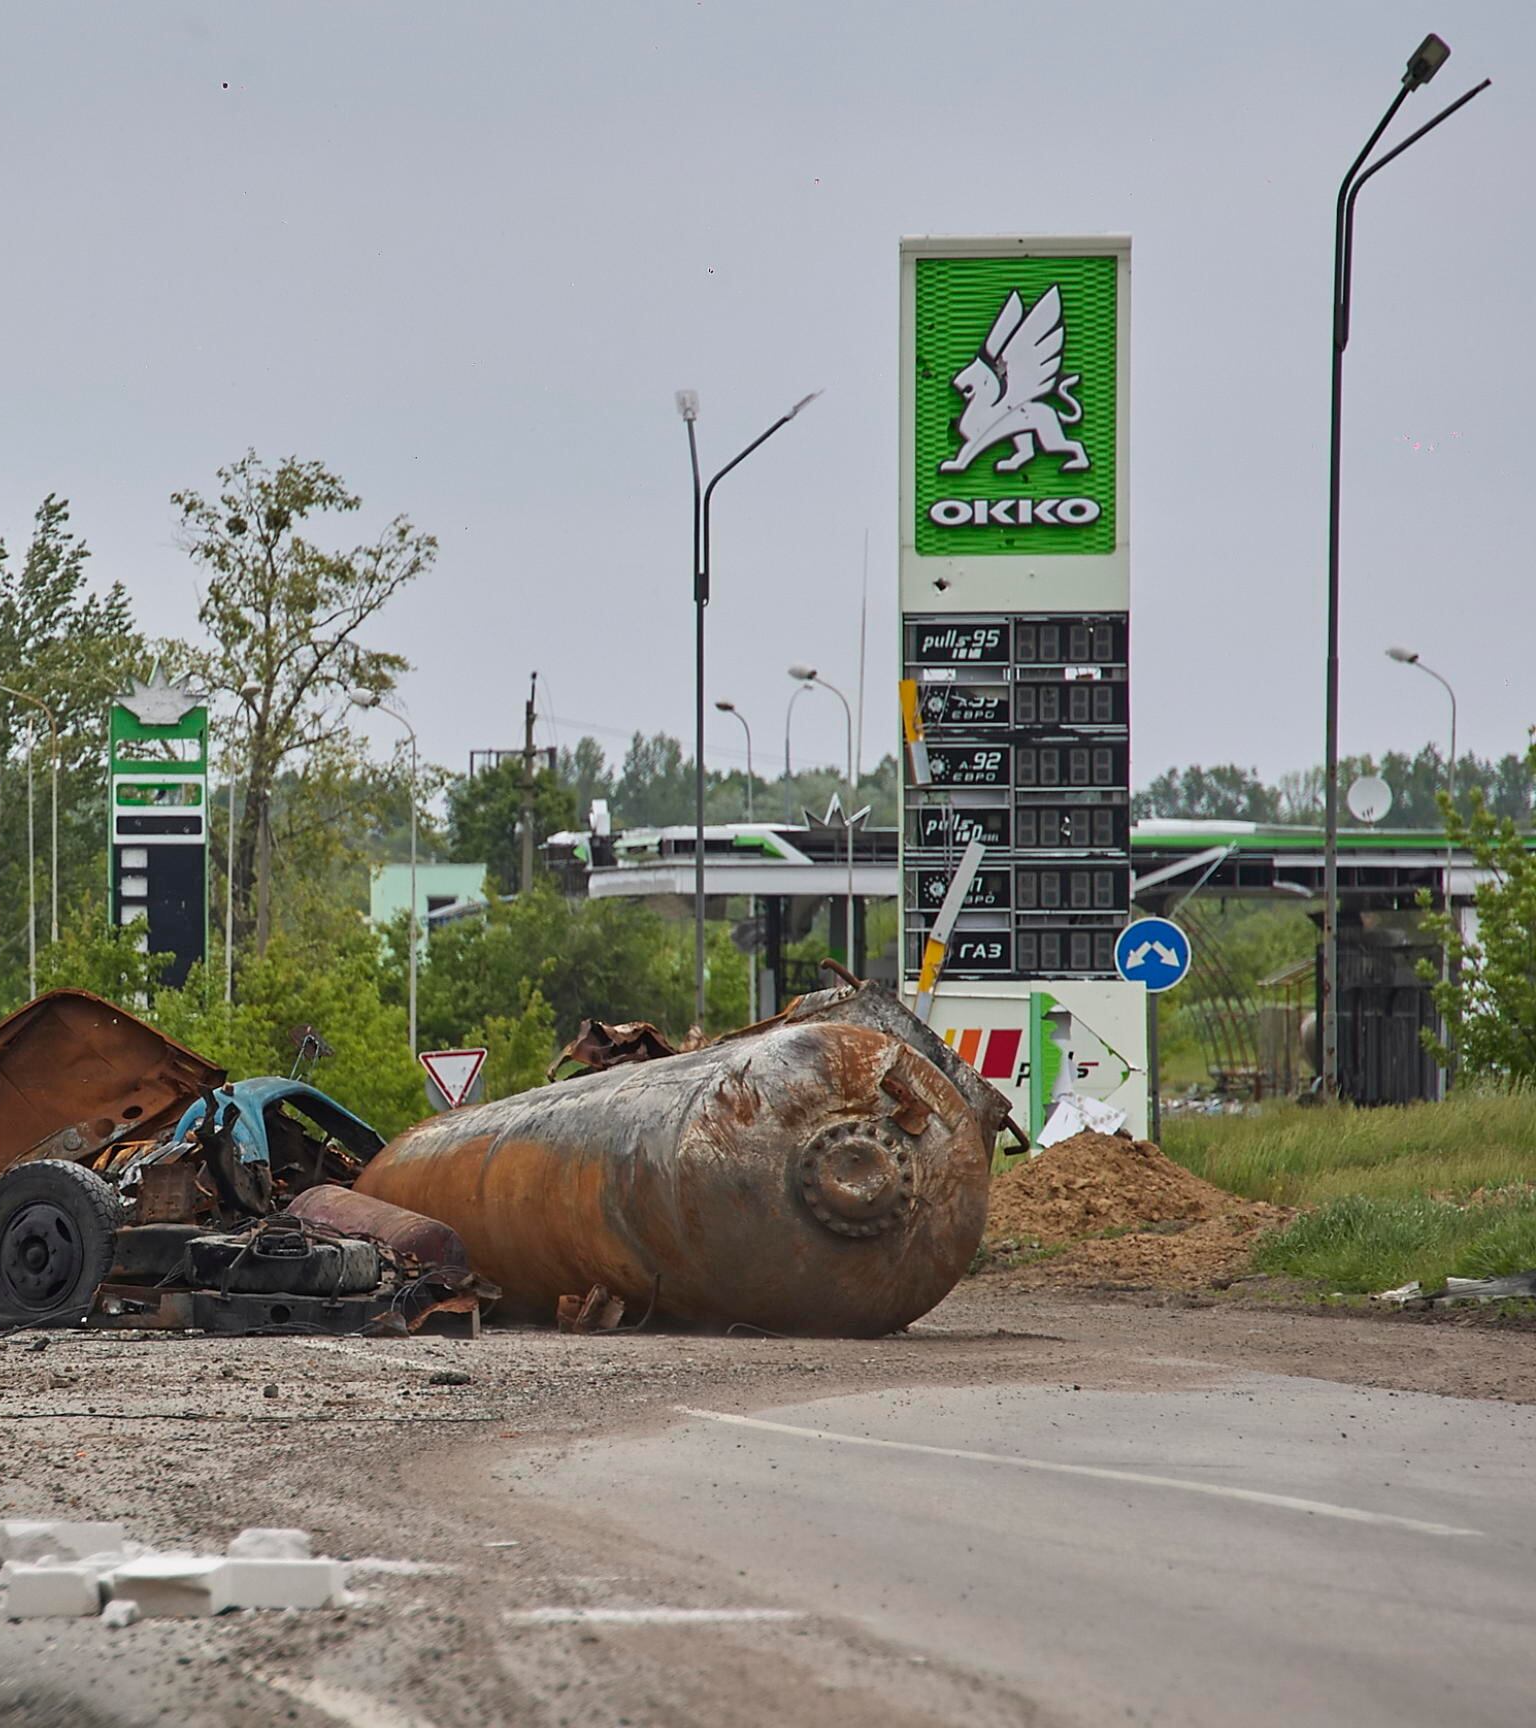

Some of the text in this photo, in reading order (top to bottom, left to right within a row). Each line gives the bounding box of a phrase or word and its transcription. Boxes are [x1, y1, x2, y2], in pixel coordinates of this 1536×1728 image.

[928, 497, 1102, 526] OKKO
[971, 629, 1001, 648] 95
[960, 943, 1002, 959] ГАЗ
